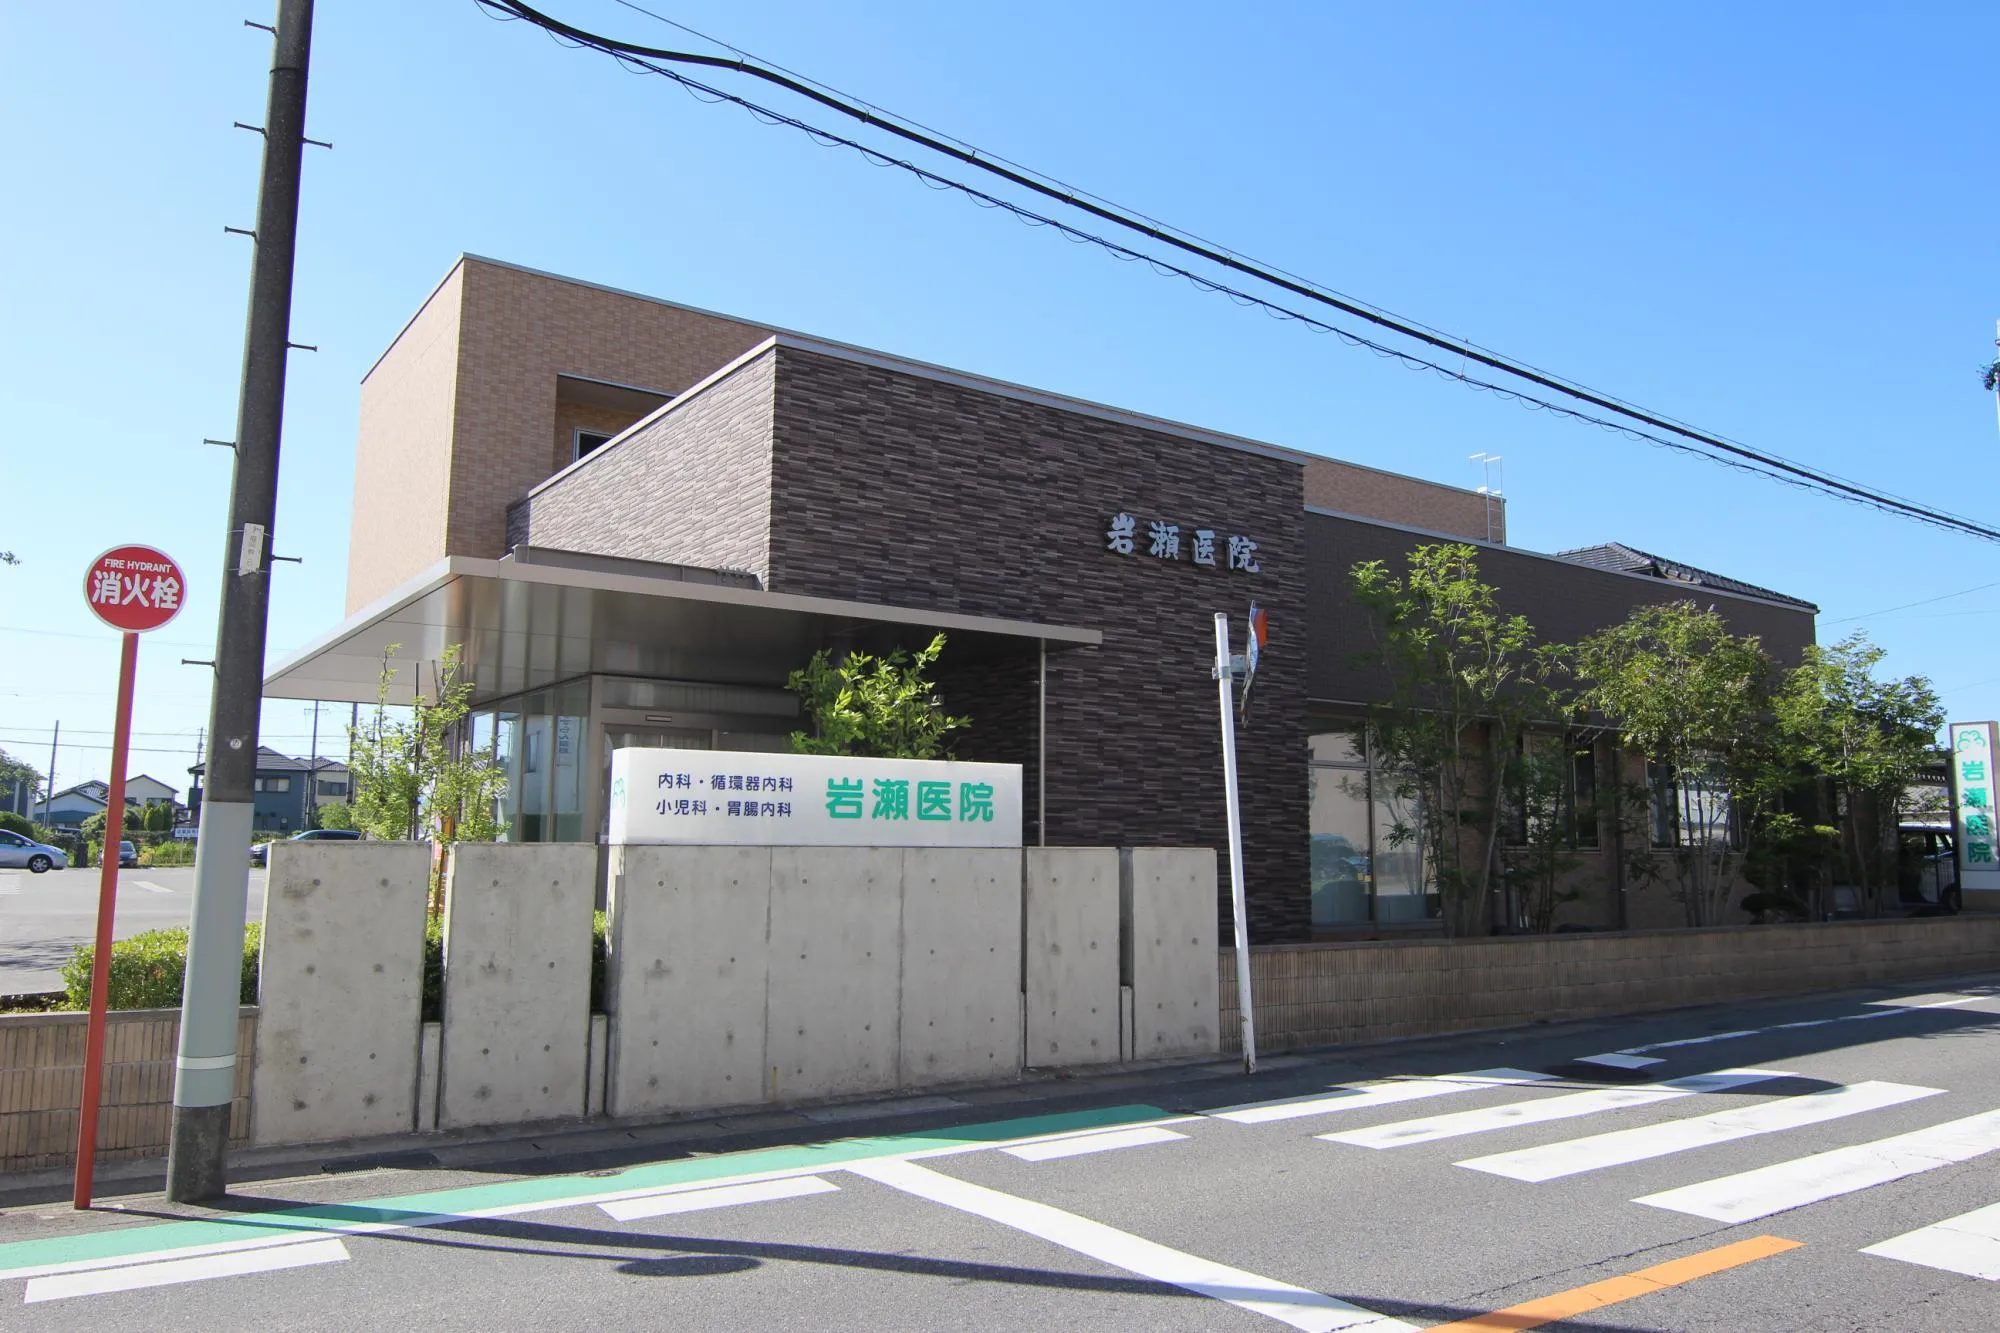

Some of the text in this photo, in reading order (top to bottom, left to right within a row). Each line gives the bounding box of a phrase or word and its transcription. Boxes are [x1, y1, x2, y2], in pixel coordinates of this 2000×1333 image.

[1107, 512, 1260, 573] 岩瀬医院
[104, 558, 173, 573] FIRE HYDRANT
[92, 570, 180, 609] 消火栓
[658, 772, 793, 792] 内科・循環器内科
[656, 799, 793, 817] 小児科・胃腸内科
[825, 777, 994, 823] 岩瀬医院
